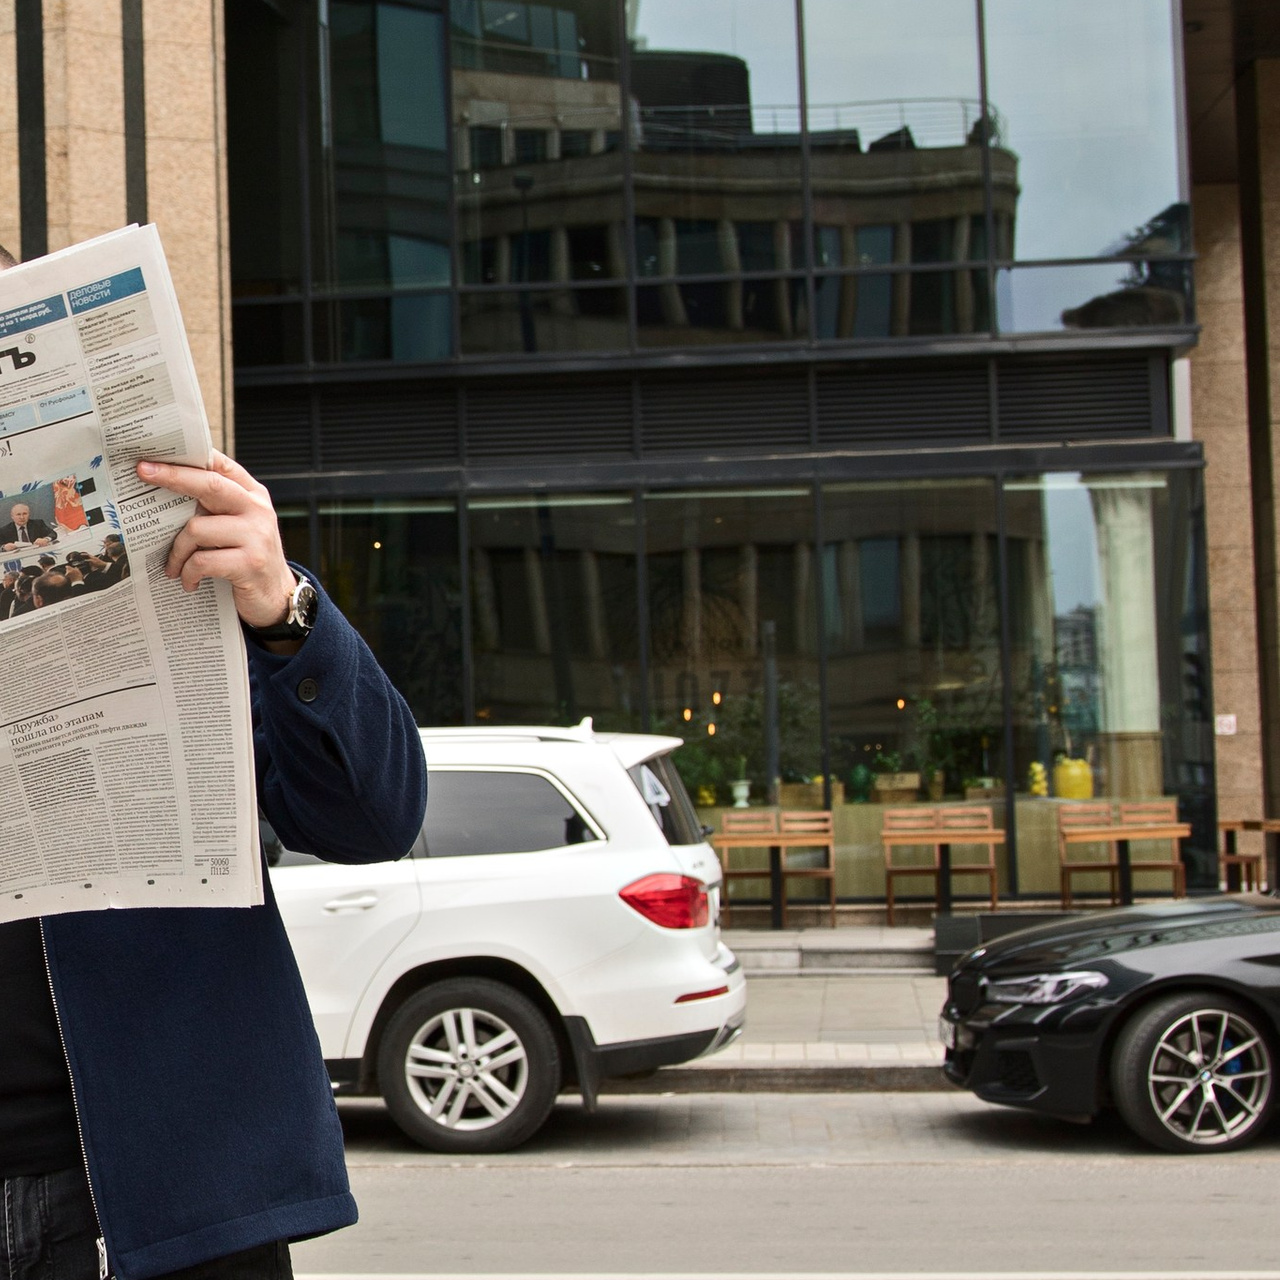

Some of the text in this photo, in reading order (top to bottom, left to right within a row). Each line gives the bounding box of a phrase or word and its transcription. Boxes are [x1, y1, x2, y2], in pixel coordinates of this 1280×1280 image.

[69, 279, 111, 300] деловые
[71, 288, 110, 307] новости
[119, 496, 156, 514] Россия
[126, 518, 160, 535] вином
[8, 714, 59, 736] «Дружба»
[10, 710, 104, 746] пошла по этапам
[12, 723, 99, 753] Украина пытается поднять
[14, 721, 147, 759] цену транзита российской нефти дважды
[210, 858, 229, 866] 50060
[211, 867, 230, 876] П1125
